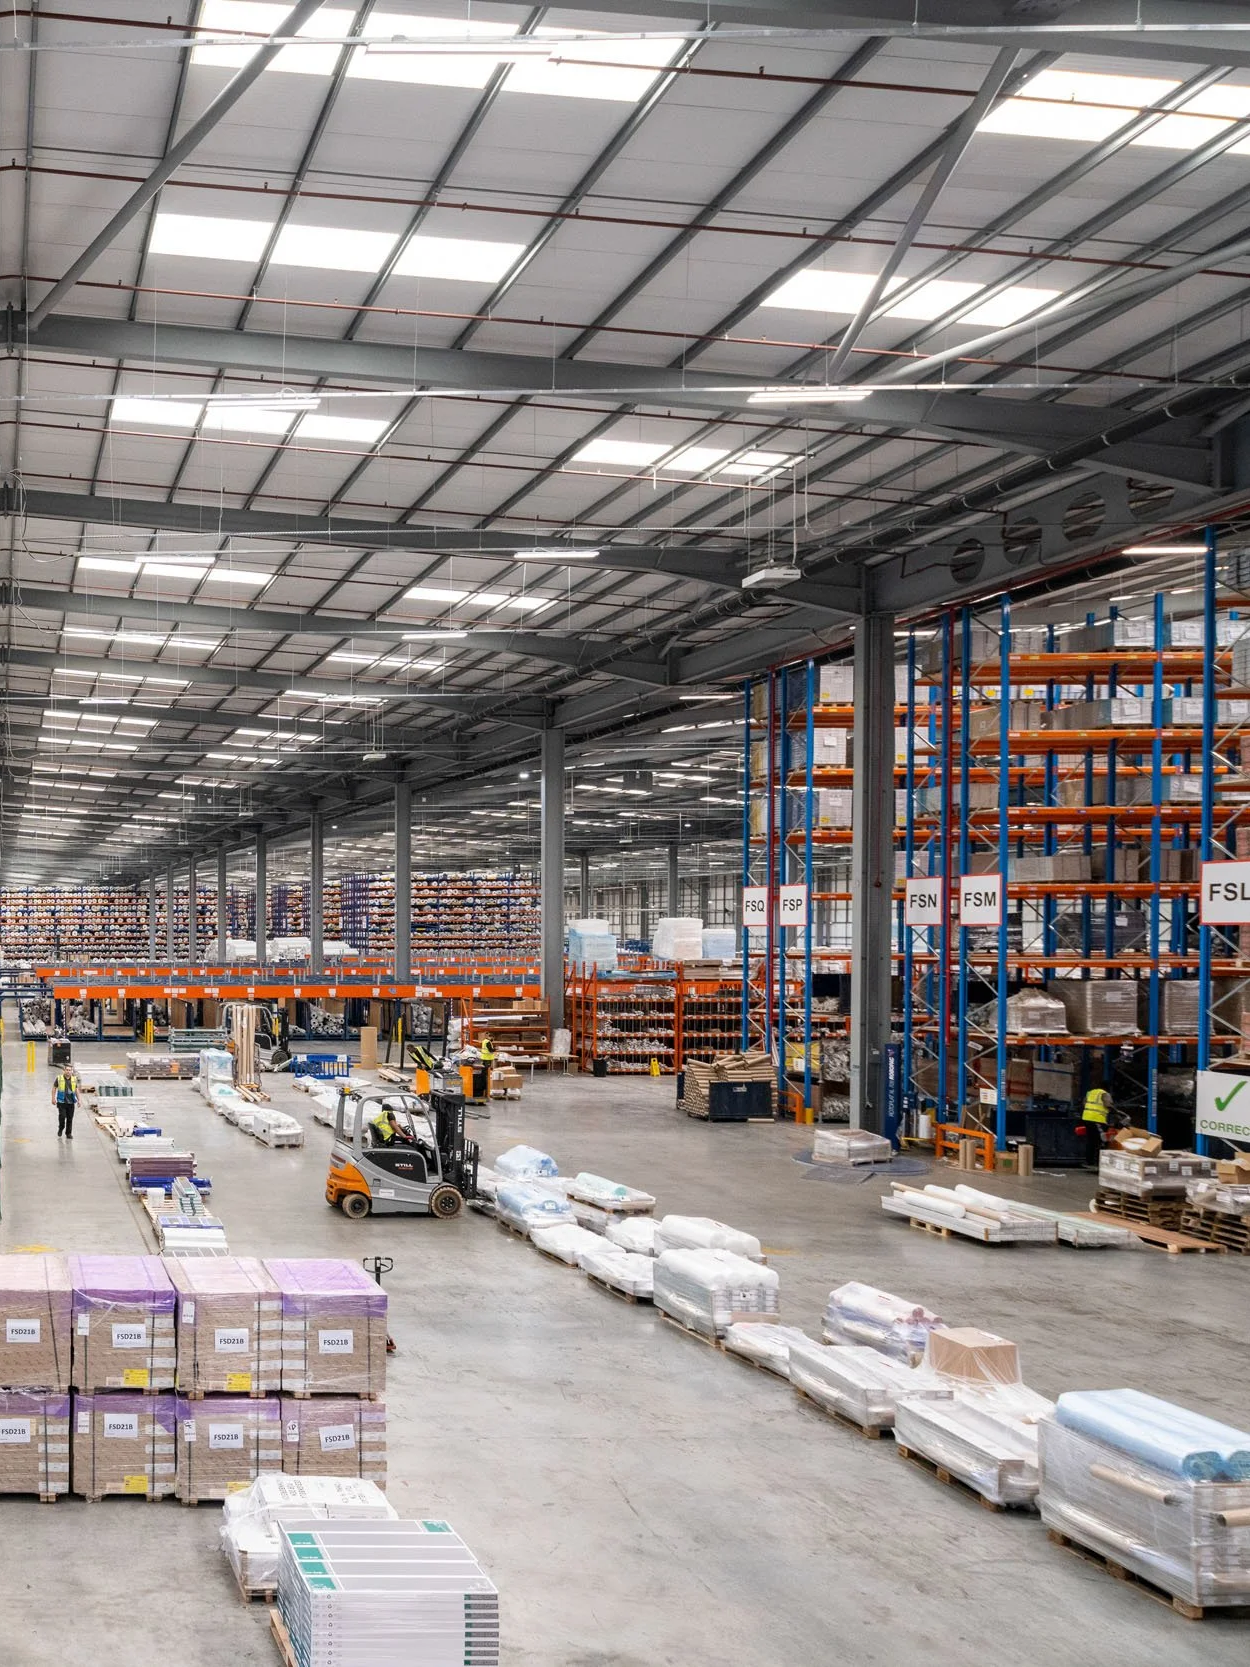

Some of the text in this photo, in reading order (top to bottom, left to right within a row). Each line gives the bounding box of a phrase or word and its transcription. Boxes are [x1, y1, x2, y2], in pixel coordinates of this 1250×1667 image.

[1209, 882, 1250, 902] FSL
[745, 899, 765, 913] FSQ
[782, 898, 803, 912] FSP
[909, 893, 937, 909] FSN
[964, 891, 996, 908] FSM
[213, 1433, 239, 1441] FSD21B
[324, 1434, 350, 1443] FSD21B
